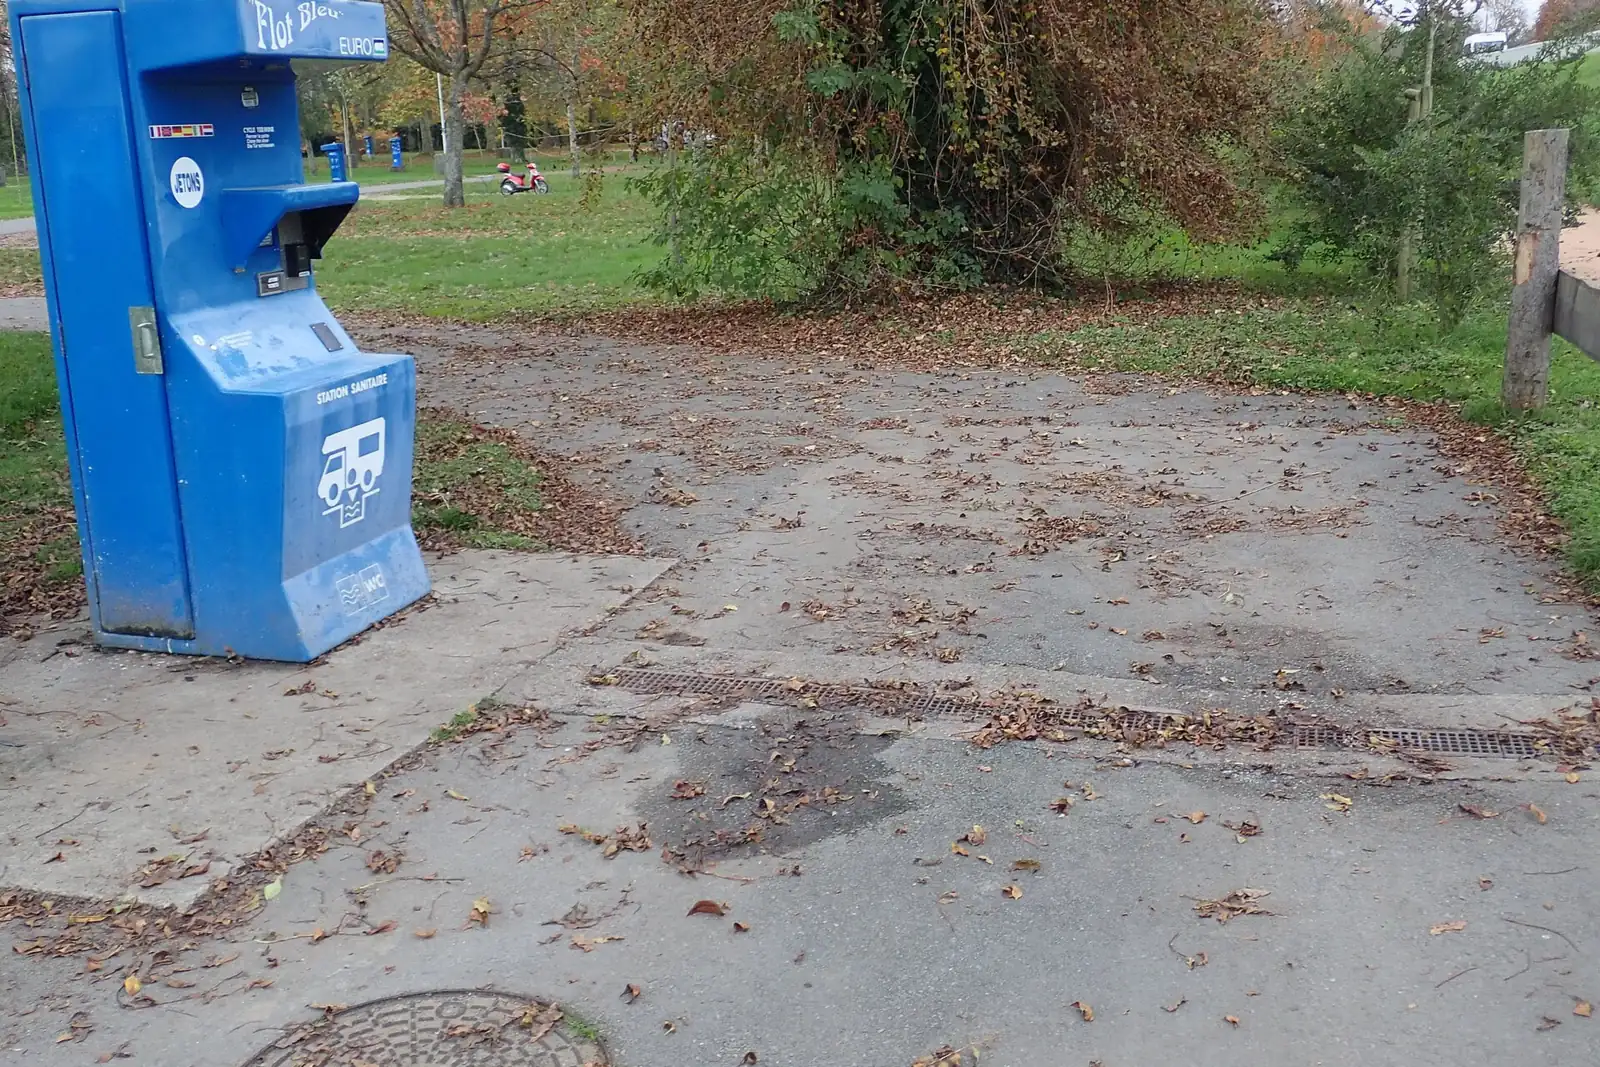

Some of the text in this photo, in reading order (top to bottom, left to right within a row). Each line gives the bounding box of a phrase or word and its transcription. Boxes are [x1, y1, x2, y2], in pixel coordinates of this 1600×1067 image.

[339, 36, 372, 56] EURO
[174, 171, 201, 194] JETONS
[316, 373, 388, 405] STATION SANITAIRE
[363, 573, 385, 593] WC
